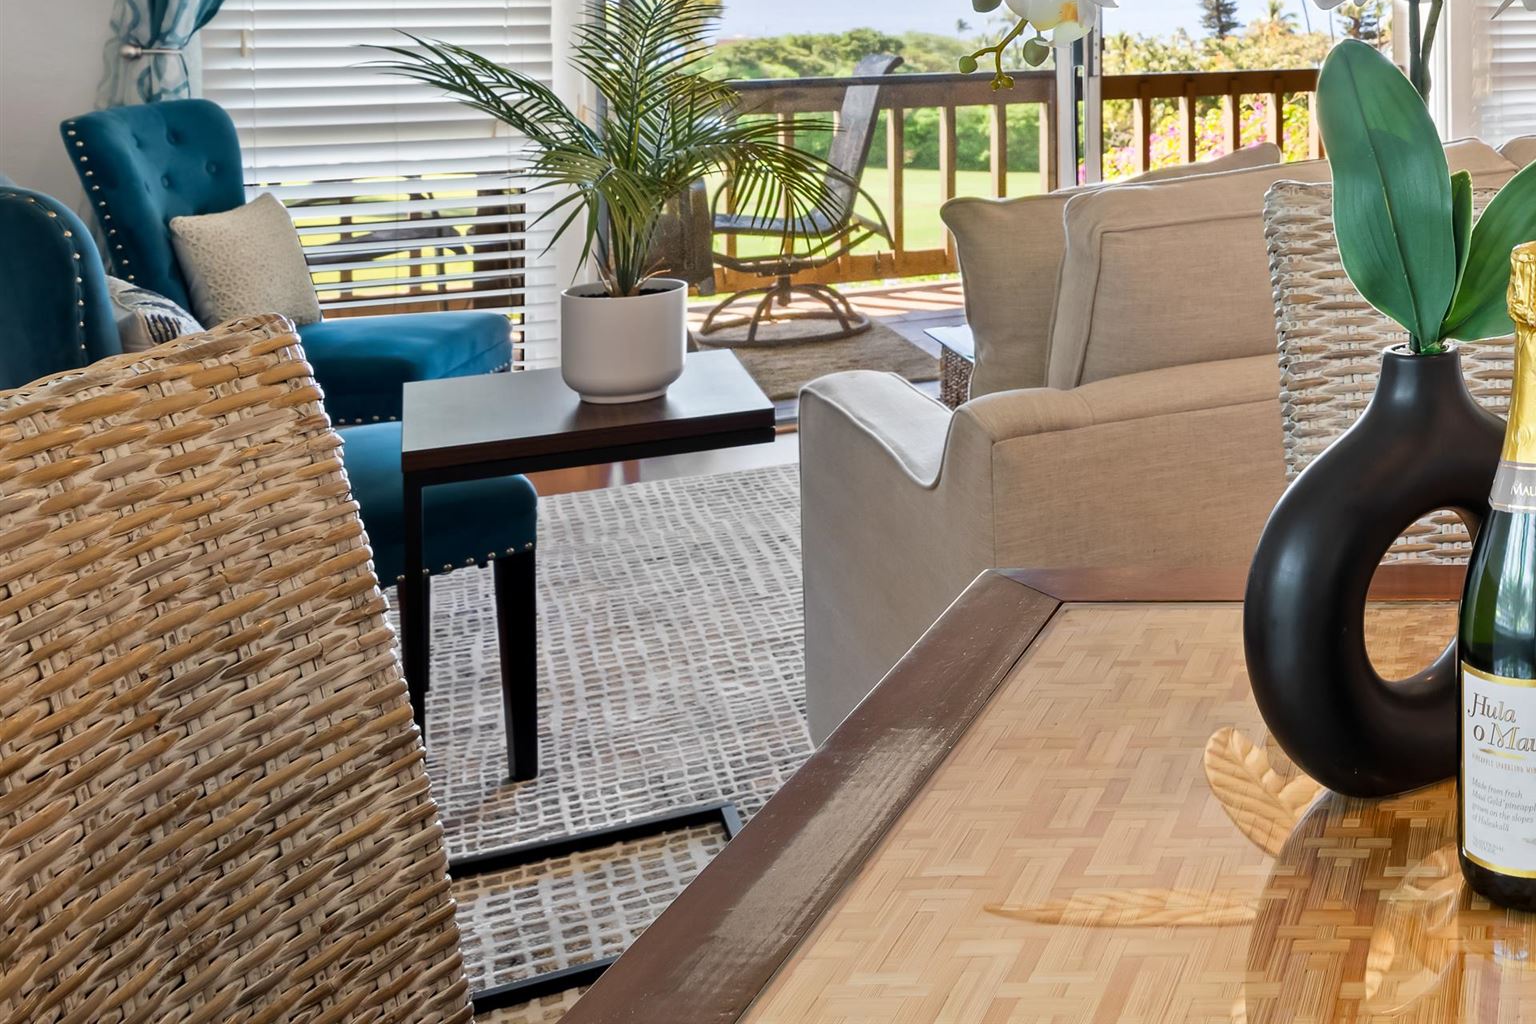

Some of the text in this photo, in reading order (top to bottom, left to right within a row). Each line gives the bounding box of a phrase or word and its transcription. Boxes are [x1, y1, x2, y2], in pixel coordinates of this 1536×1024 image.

[1467, 692, 1517, 723] Hula
[1473, 724, 1486, 742] o
[1472, 777, 1523, 799] Made from fresh
[1489, 809, 1498, 817] on
[1499, 810, 1511, 821] the
[1512, 812, 1534, 824] slopes
